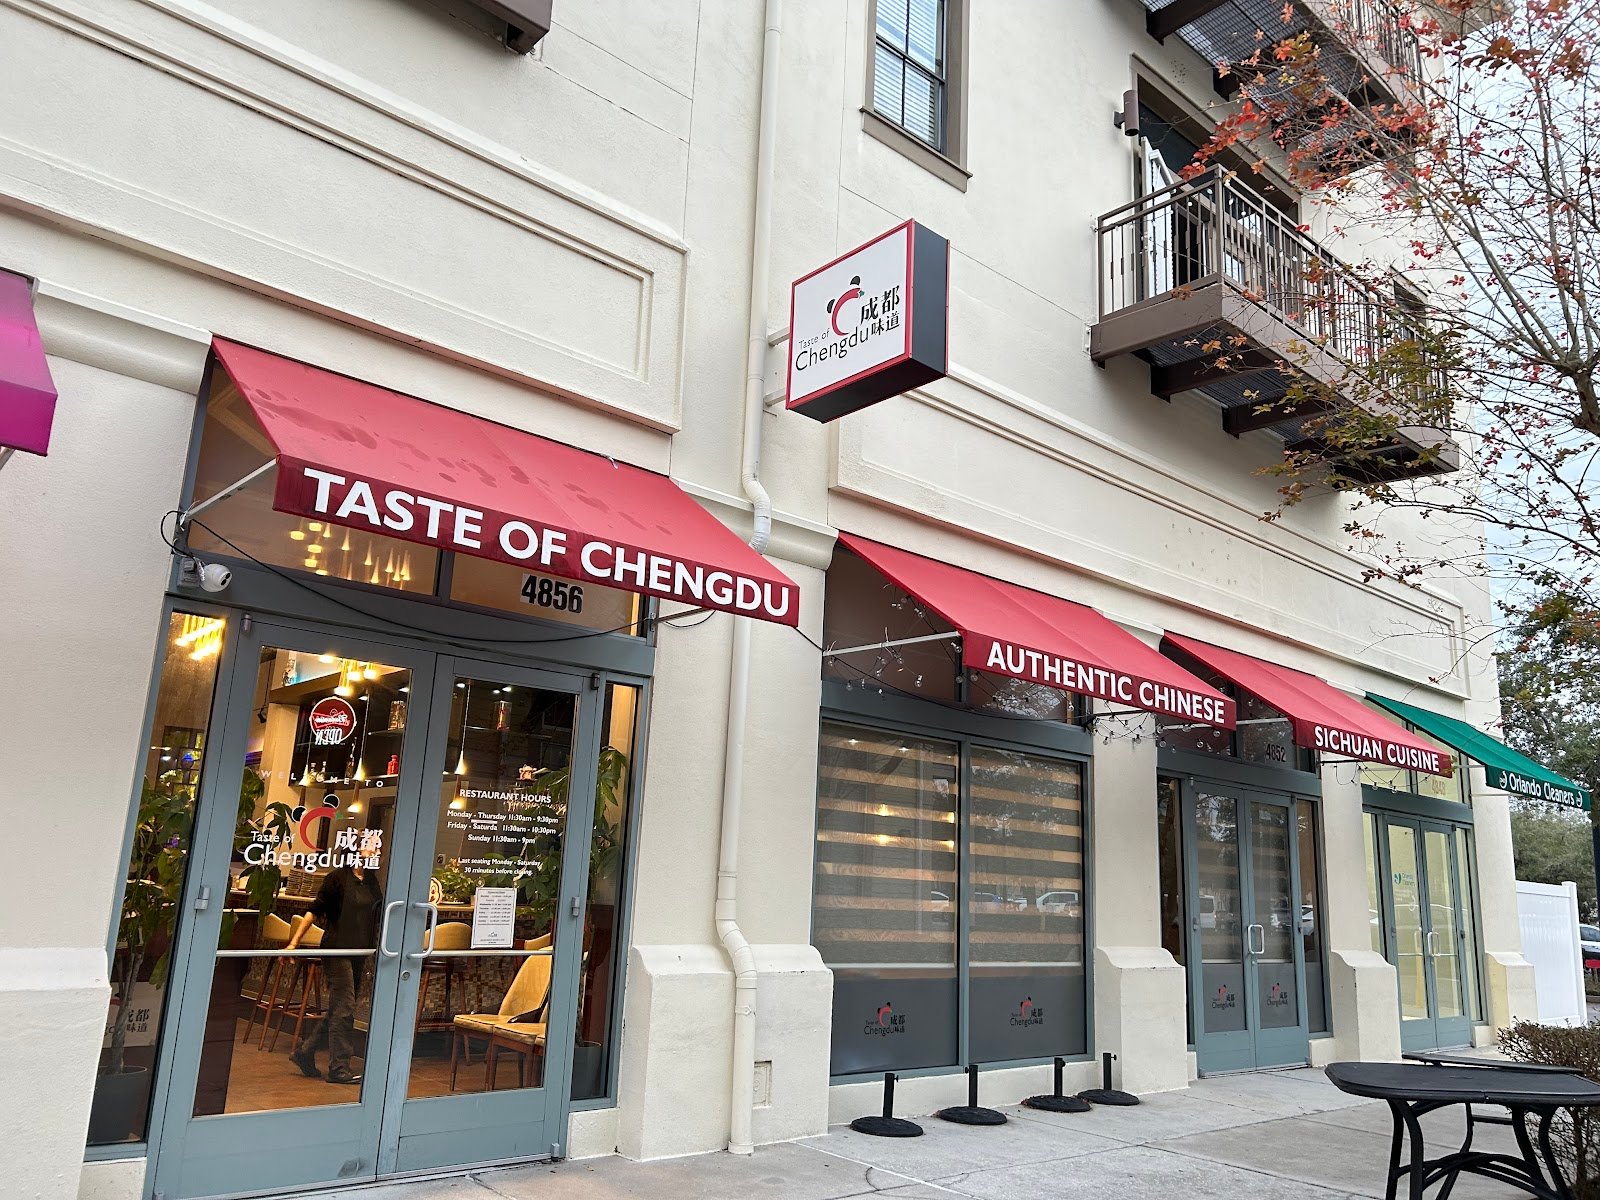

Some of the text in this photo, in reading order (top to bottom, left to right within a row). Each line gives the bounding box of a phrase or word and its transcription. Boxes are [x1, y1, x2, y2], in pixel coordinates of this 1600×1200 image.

[860, 285, 900, 326] 成都
[871, 310, 900, 336] 味道
[795, 326, 869, 371] Chengdu
[798, 327, 830, 350] Taste of
[304, 467, 789, 617] TASTE OF CHENGDU
[521, 574, 584, 614] 4856
[986, 641, 1225, 724] AUTHENTIC CHINESE
[1265, 743, 1287, 763] 4852
[1314, 725, 1440, 773] SICHUAN CUISINE
[261, 769, 384, 788] WELOME TO
[1509, 772, 1575, 805] Orlando Cleaners
[460, 788, 552, 804] RESTAURANT HOURS
[447, 809, 473, 820] Monday
[477, 811, 507, 822] Thursday
[508, 813, 532, 822] 11:30am
[536, 815, 559, 825] 9:30pm
[250, 830, 296, 844] Taste of
[334, 826, 384, 852] 成都
[447, 821, 468, 831] Friday
[502, 824, 527, 833] 11:30am
[531, 826, 557, 836] 10:30pm
[467, 833, 492, 844] Sunday
[492, 835, 517, 843] 11:30am
[521, 836, 536, 845] 9pm
[243, 843, 345, 873] Chengdu
[346, 851, 381, 870] 味道
[458, 856, 471, 865] Last
[471, 857, 491, 866] seating
[491, 858, 513, 867] Monday
[472, 867, 495, 875] minutes
[863, 1025, 895, 1037] Chengdu
